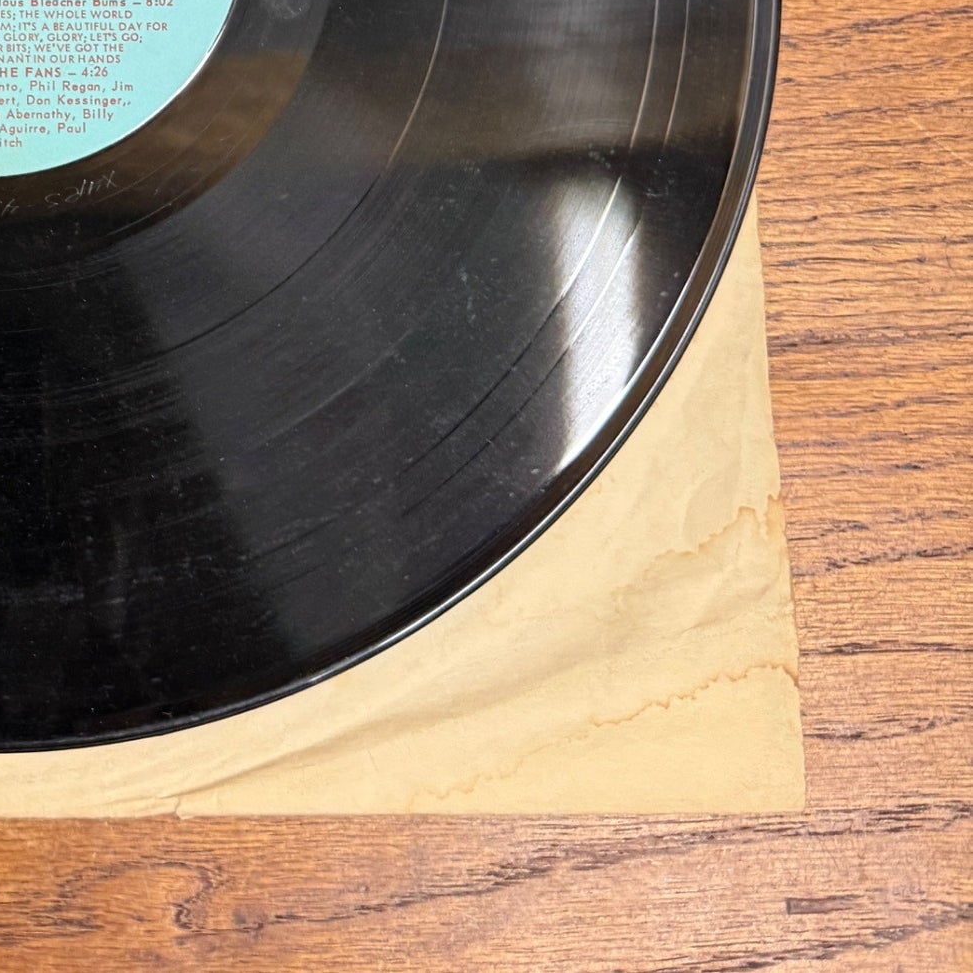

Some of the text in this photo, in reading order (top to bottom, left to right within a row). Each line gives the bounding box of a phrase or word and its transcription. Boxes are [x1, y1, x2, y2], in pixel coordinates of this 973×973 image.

[19, 10, 39, 18] THE
[44, 10, 86, 19] WHOLE
[90, 10, 133, 19] WORLD
[18, 21, 37, 32] IT'S
[41, 22, 50, 31] A
[53, 21, 115, 32] BEAUTIFUL
[118, 22, 142, 31] DAY
[146, 22, 167, 31] FOR
[3, 32, 43, 44] GLORY,
[47, 32, 88, 44] GLORY;
[90, 32, 117, 43] LET'S
[120, 33, 142, 44] GO;
[6, 43, 31, 54] BITS;
[34, 43, 70, 52] WE'VE
[75, 43, 99, 52] GOT
[103, 43, 123, 52] THE
[34, 55, 45, 63] IN
[50, 55, 74, 63] OUR
[78, 55, 120, 65] HANDS
[25, 67, 61, 78] FANS
[81, 66, 108, 77] 4:26
[30, 80, 55, 91] Phil
[62, 80, 105, 94] Regan,
[111, 81, 133, 91] Jim
[27, 94, 50, 105] Don
[6, 108, 75, 123] Abernathy,
[83, 108, 113, 123] Billy
[0, 123, 50, 136] Aguirre,
[58, 121, 86, 133] Paul
